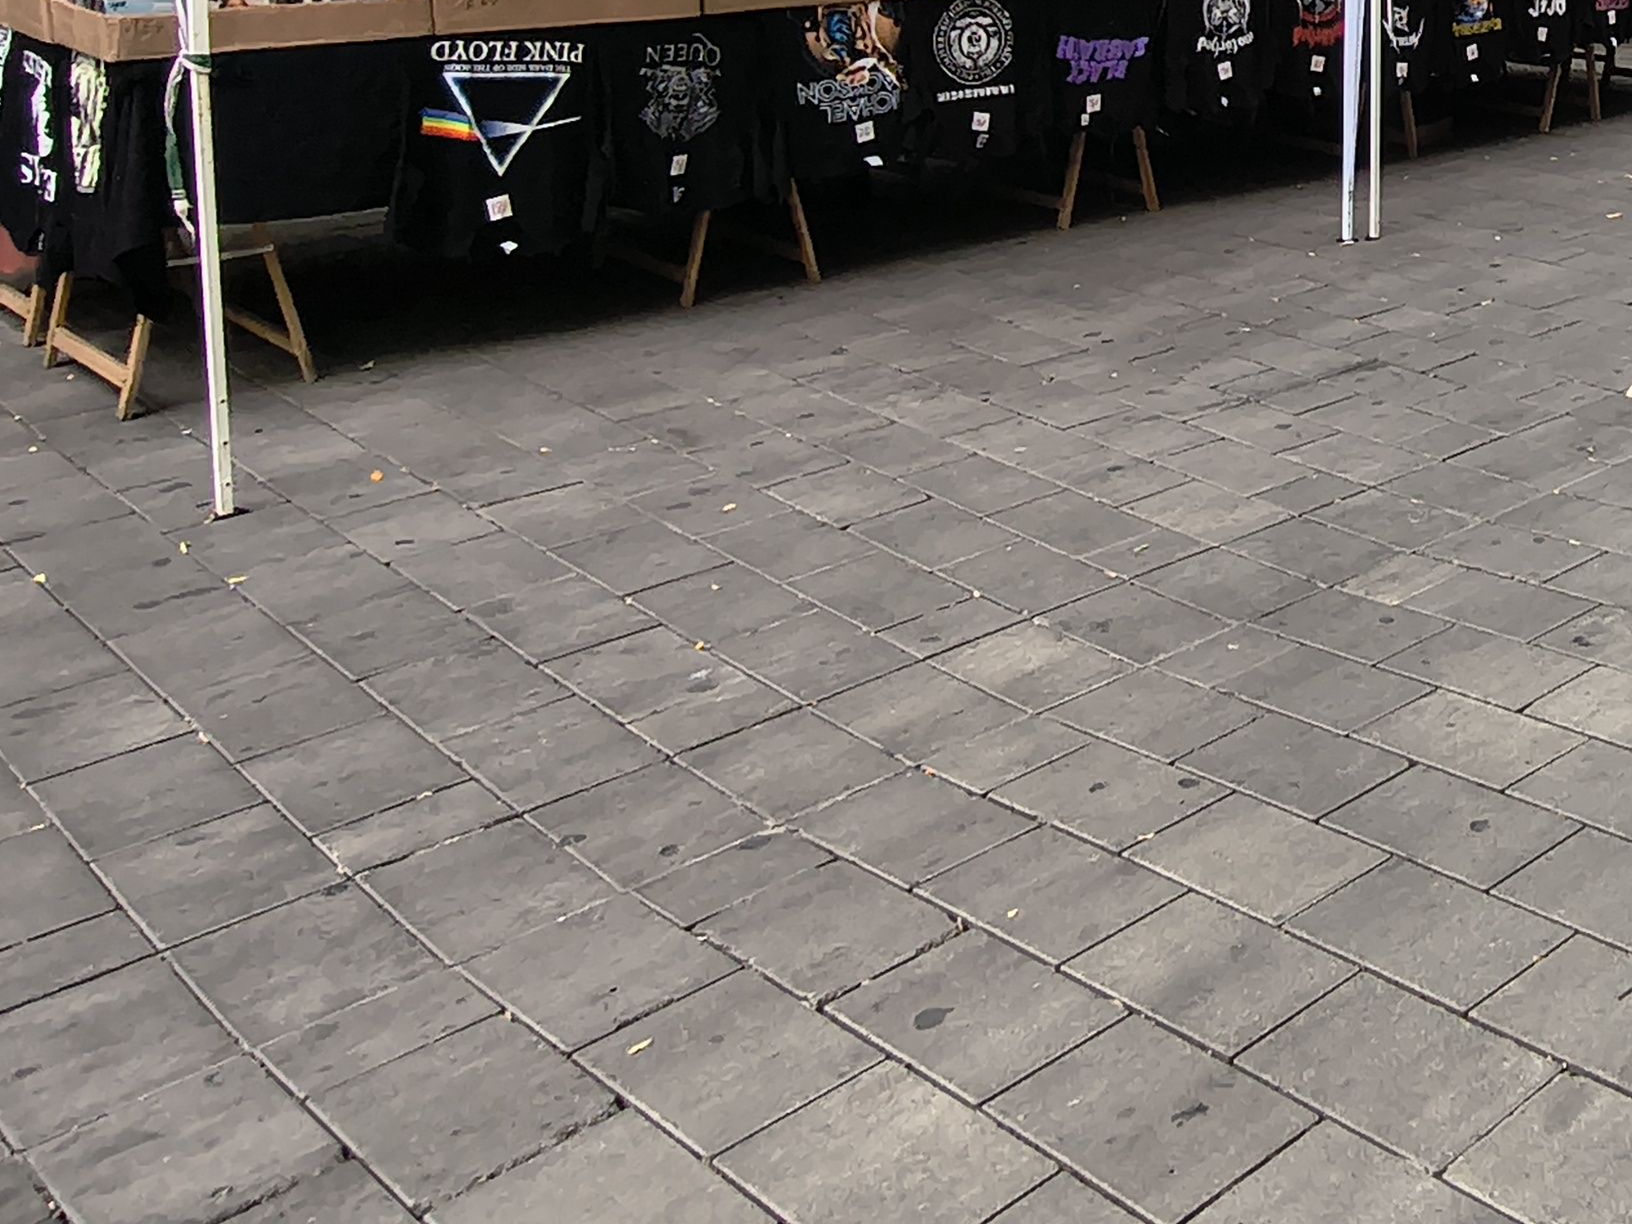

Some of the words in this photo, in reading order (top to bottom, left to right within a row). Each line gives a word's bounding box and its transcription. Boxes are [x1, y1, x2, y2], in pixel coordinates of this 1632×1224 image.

[430, 40, 520, 62] FLOYD
[523, 41, 586, 63] PINK
[646, 33, 721, 67] QUEEN
